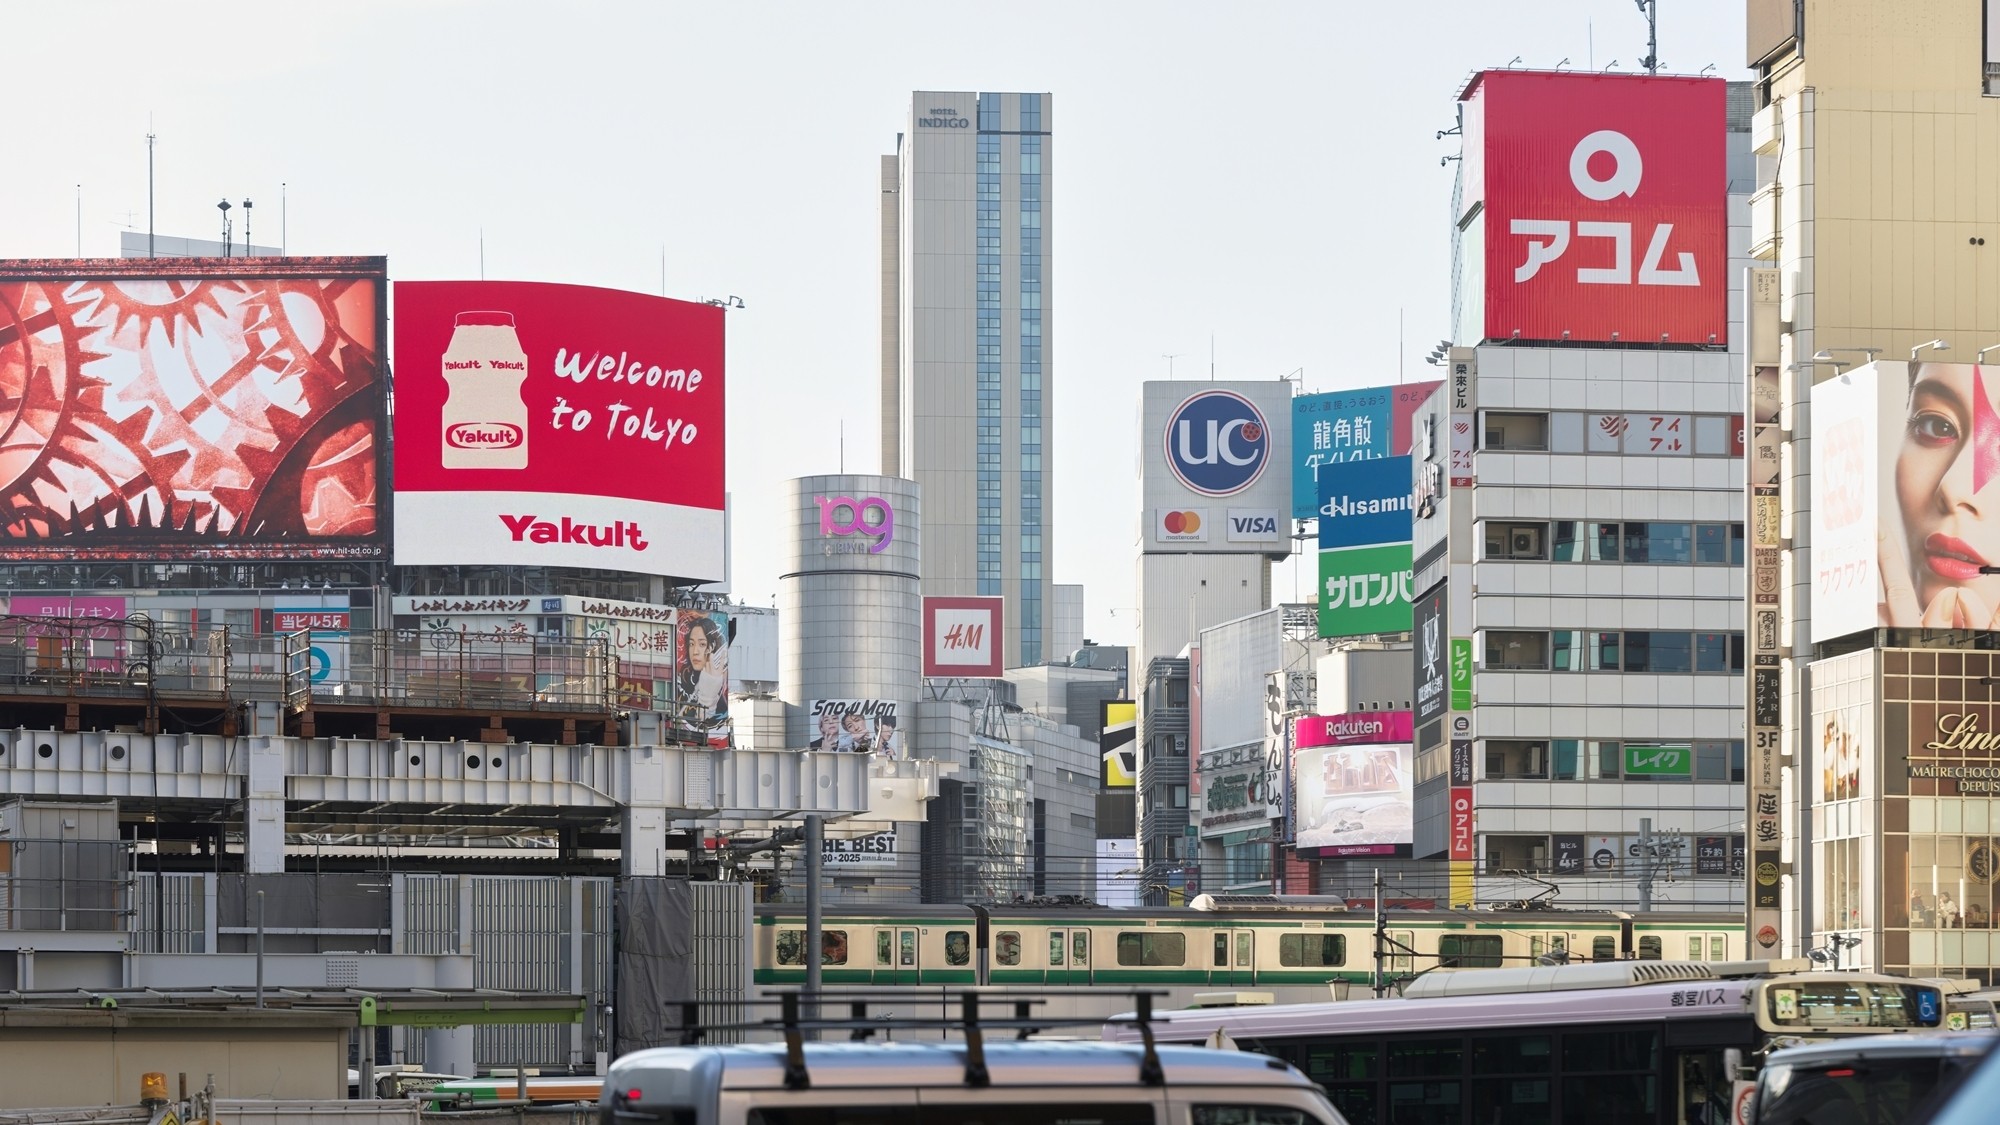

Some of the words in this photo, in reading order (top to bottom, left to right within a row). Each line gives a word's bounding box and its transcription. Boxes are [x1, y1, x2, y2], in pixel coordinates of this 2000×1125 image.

[919, 117, 969, 128] INDIGO
[1510, 219, 1701, 286] アコム
[444, 359, 482, 370] Yakult
[489, 360, 525, 371] Yakult
[554, 348, 703, 393] Welcome
[551, 396, 592, 431] to
[605, 400, 698, 450] Tokyo
[455, 428, 515, 444] Yakult
[1313, 415, 1372, 450] 龍角散
[1456, 478, 1467, 486] 8F
[1761, 488, 1773, 496] 7F
[498, 514, 649, 551] Yakult
[814, 495, 894, 554] 109
[1231, 517, 1277, 533] VISA
[317, 547, 381, 555] www.hit-ad.co.jp
[1756, 548, 1777, 557] DARTS
[1764, 557, 1778, 566] BAR
[411, 599, 531, 612] しゃぶしゃぶバイキング
[581, 601, 672, 621] しゃぶしゃぶバイキング
[616, 627, 669, 652] しゃぶ葉
[943, 623, 984, 650] H&M
[1454, 645, 1467, 682] レイク
[1760, 656, 1774, 664] 5F
[1756, 673, 1766, 716] カラオケ
[811, 700, 863, 716] Snow
[861, 700, 896, 716] Man
[1763, 716, 1772, 724] 4F
[1326, 720, 1383, 737] Rakuten
[1756, 732, 1778, 748] 3F
[1633, 751, 1680, 768] レイク
[1960, 781, 2000, 792] DEPUIS
[1456, 814, 1468, 852] アコム
[852, 837, 895, 853] BEST
[838, 854, 861, 862] 2025
[1559, 853, 1578, 868] 4F
[1761, 896, 1774, 904] 2F
[1670, 988, 1726, 1007] 都営バス
